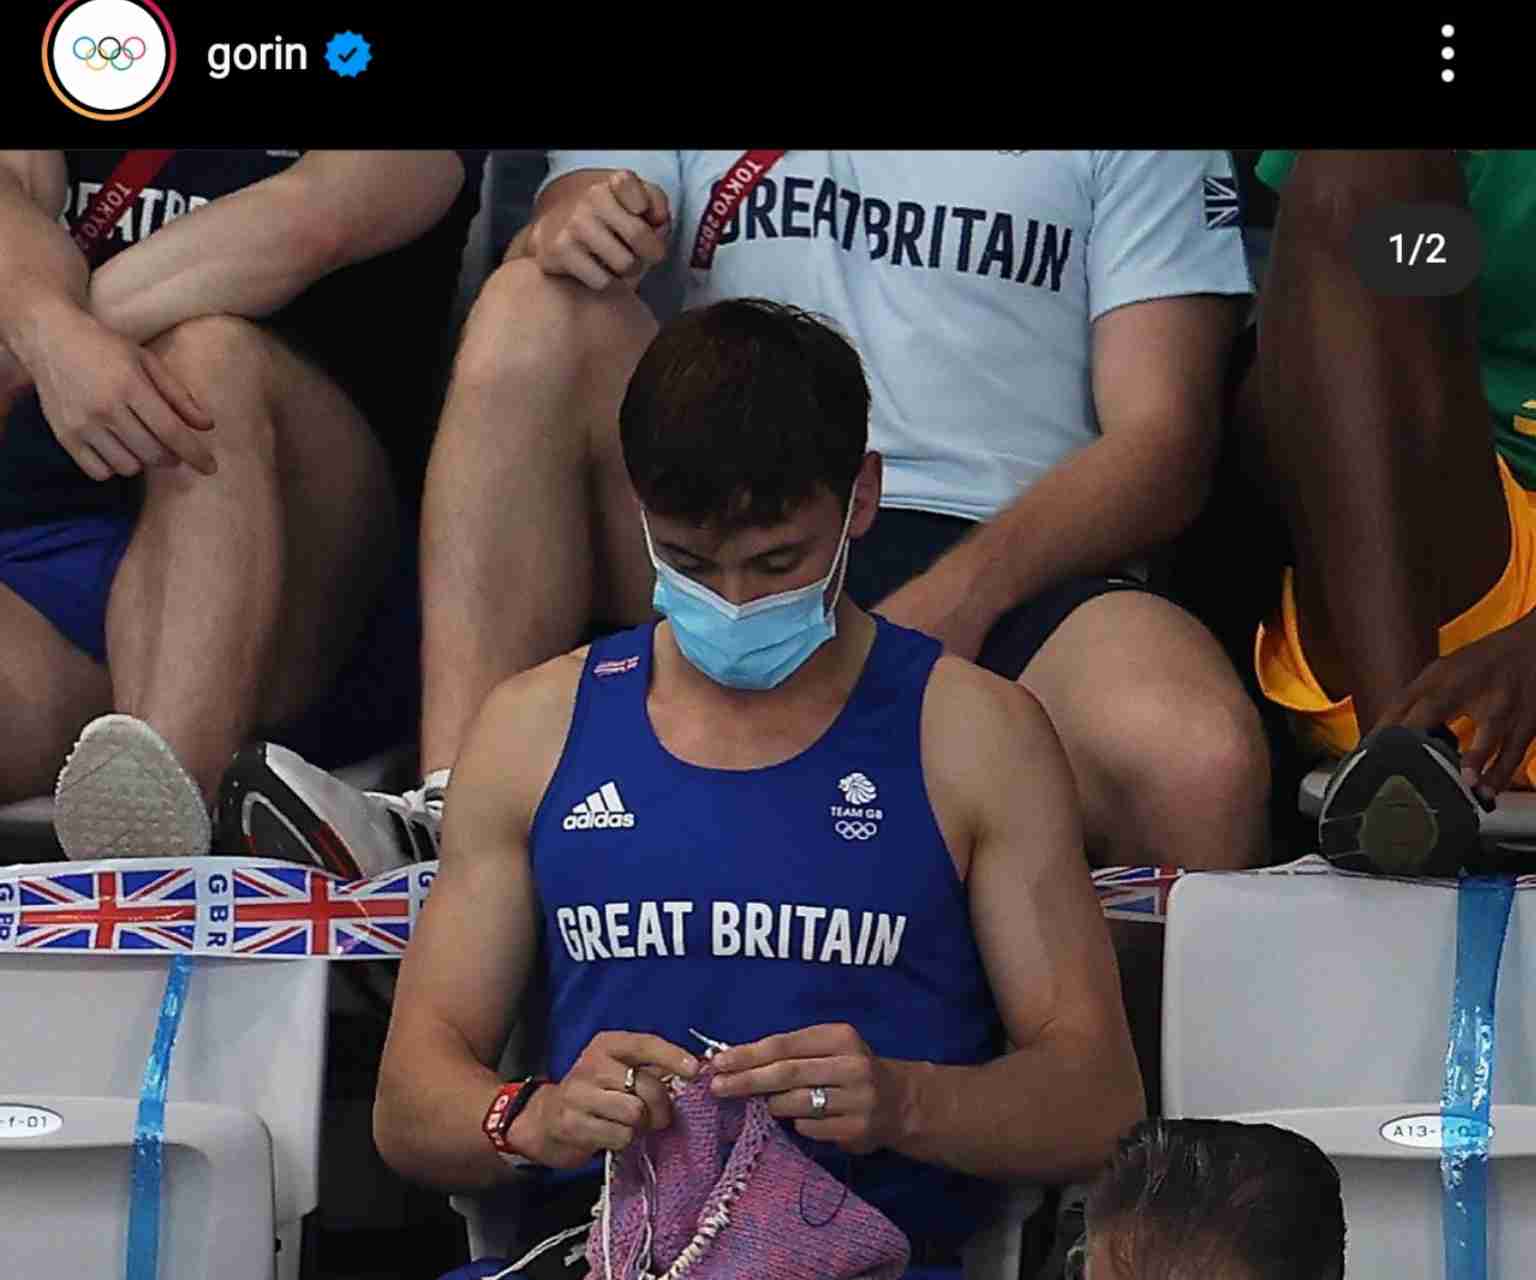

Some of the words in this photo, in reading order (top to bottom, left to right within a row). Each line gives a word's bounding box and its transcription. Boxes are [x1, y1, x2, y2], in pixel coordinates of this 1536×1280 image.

[712, 159, 764, 218] TOKYO
[863, 197, 1073, 293] BRITAIN
[563, 811, 635, 831] adidas
[830, 805, 863, 818] TEAM
[865, 807, 884, 821] GB
[556, 900, 693, 963] GREAT
[711, 900, 907, 967] BRITAIN
